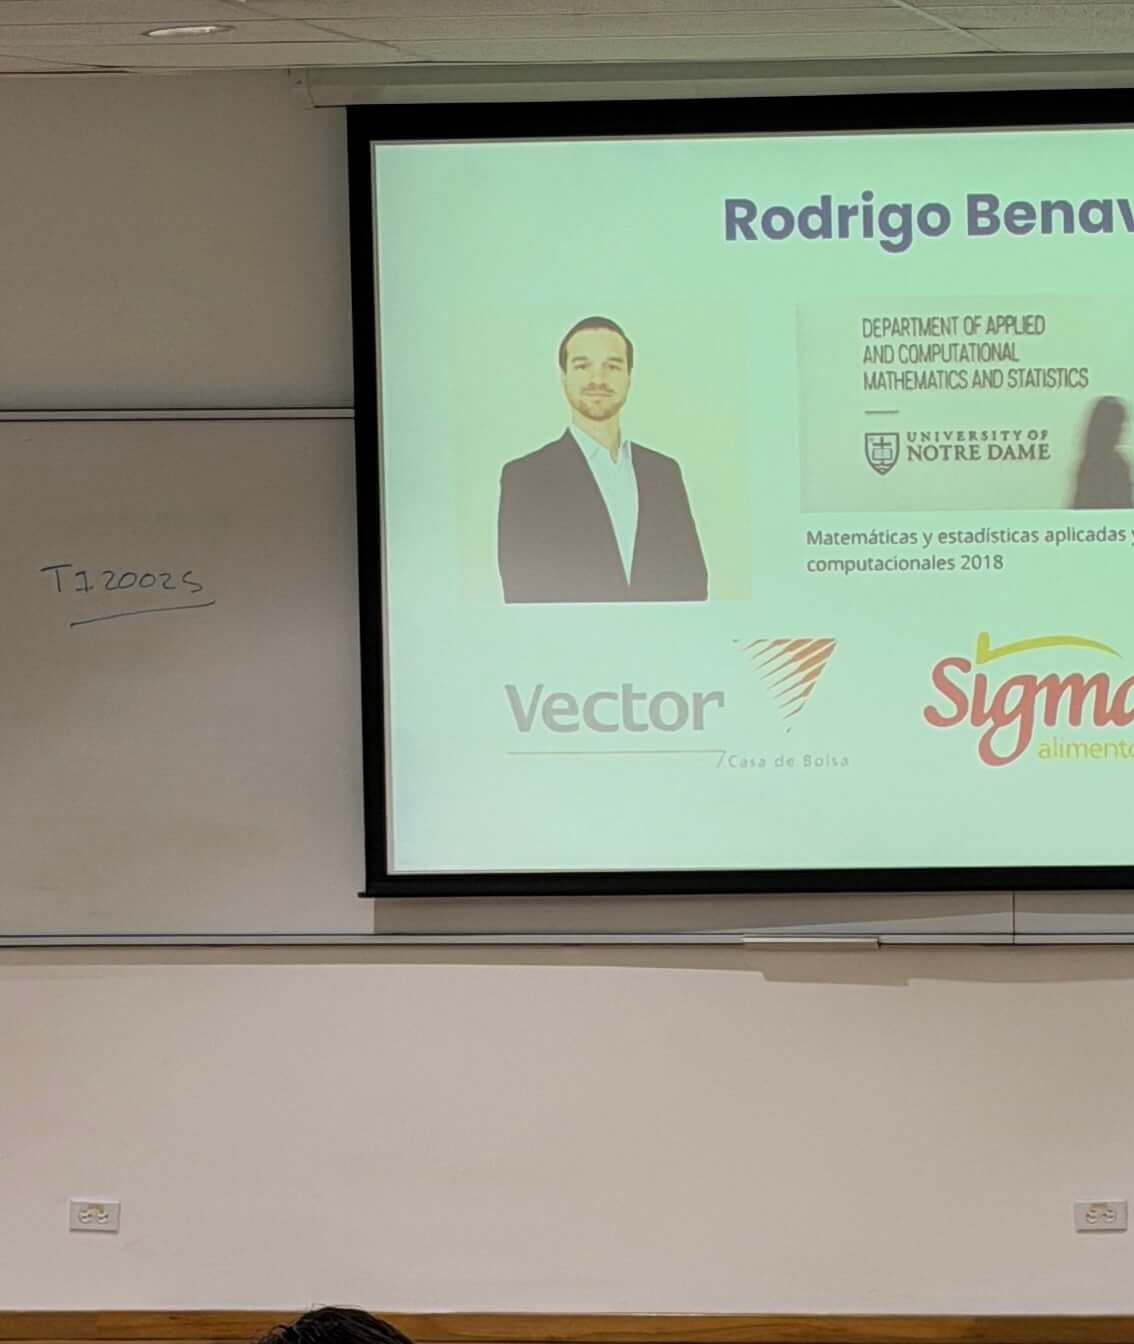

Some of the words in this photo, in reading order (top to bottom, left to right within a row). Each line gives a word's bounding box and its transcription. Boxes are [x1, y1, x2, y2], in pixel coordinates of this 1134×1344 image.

[723, 190, 952, 253] Rodrigo
[862, 316, 959, 338] DEPARTMENT
[963, 316, 983, 335] OF
[985, 314, 1046, 335] APPLIED
[862, 344, 895, 364] AND
[898, 341, 1020, 363] COMPUTATIONAL
[863, 369, 968, 391] MATHEMATICS
[970, 369, 1004, 389] AND
[1007, 367, 1089, 388] STATISTICS
[906, 430, 1023, 443] UNIVERSITY
[1026, 429, 1051, 441] OF
[906, 442, 982, 462] NOTRE
[988, 441, 1051, 460] DAME
[806, 527, 918, 546] Matemáticas
[922, 533, 934, 549] y
[937, 525, 1040, 545] estadísticas
[1044, 525, 1126, 546] aplicadas
[806, 554, 955, 575] computacionales
[960, 554, 1004, 571] 2018
[504, 683, 725, 733] Vector
[728, 754, 767, 768] Casa
[774, 753, 795, 768] de
[803, 753, 849, 768] Bolsa
